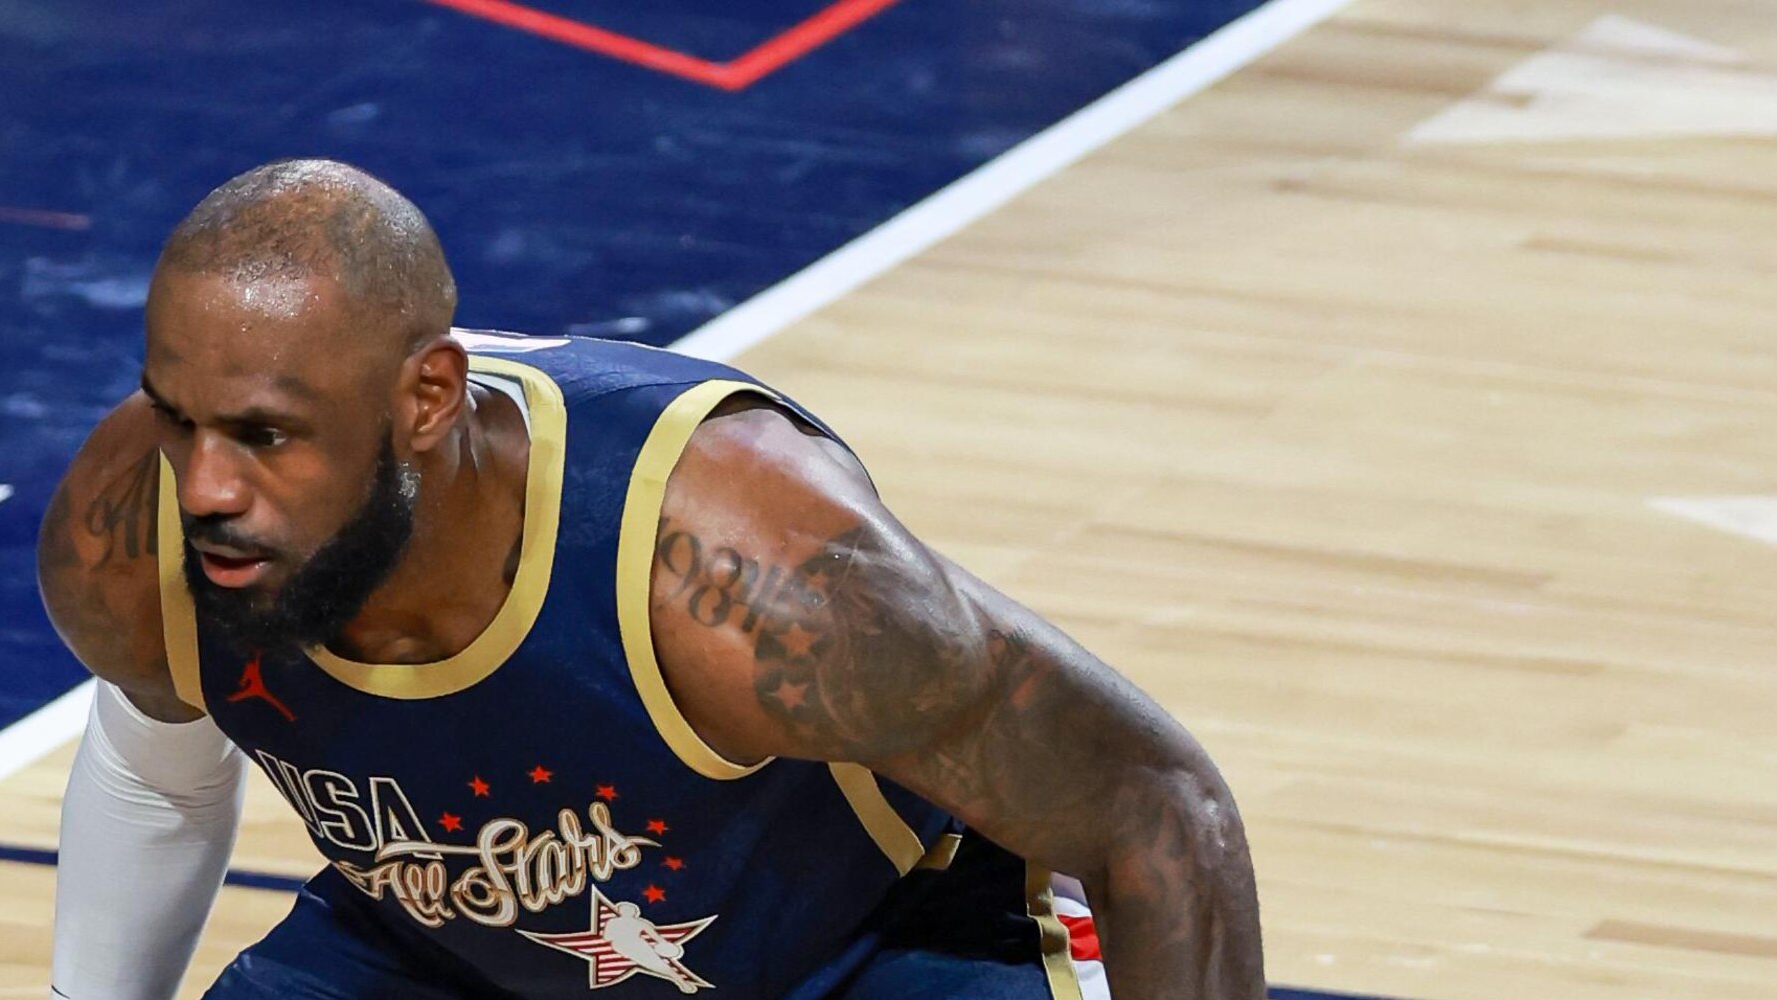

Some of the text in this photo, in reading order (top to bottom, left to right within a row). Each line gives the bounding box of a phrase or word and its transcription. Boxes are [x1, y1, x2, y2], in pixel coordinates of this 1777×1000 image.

[254, 748, 444, 860] USA
[332, 801, 663, 929] All Stars
